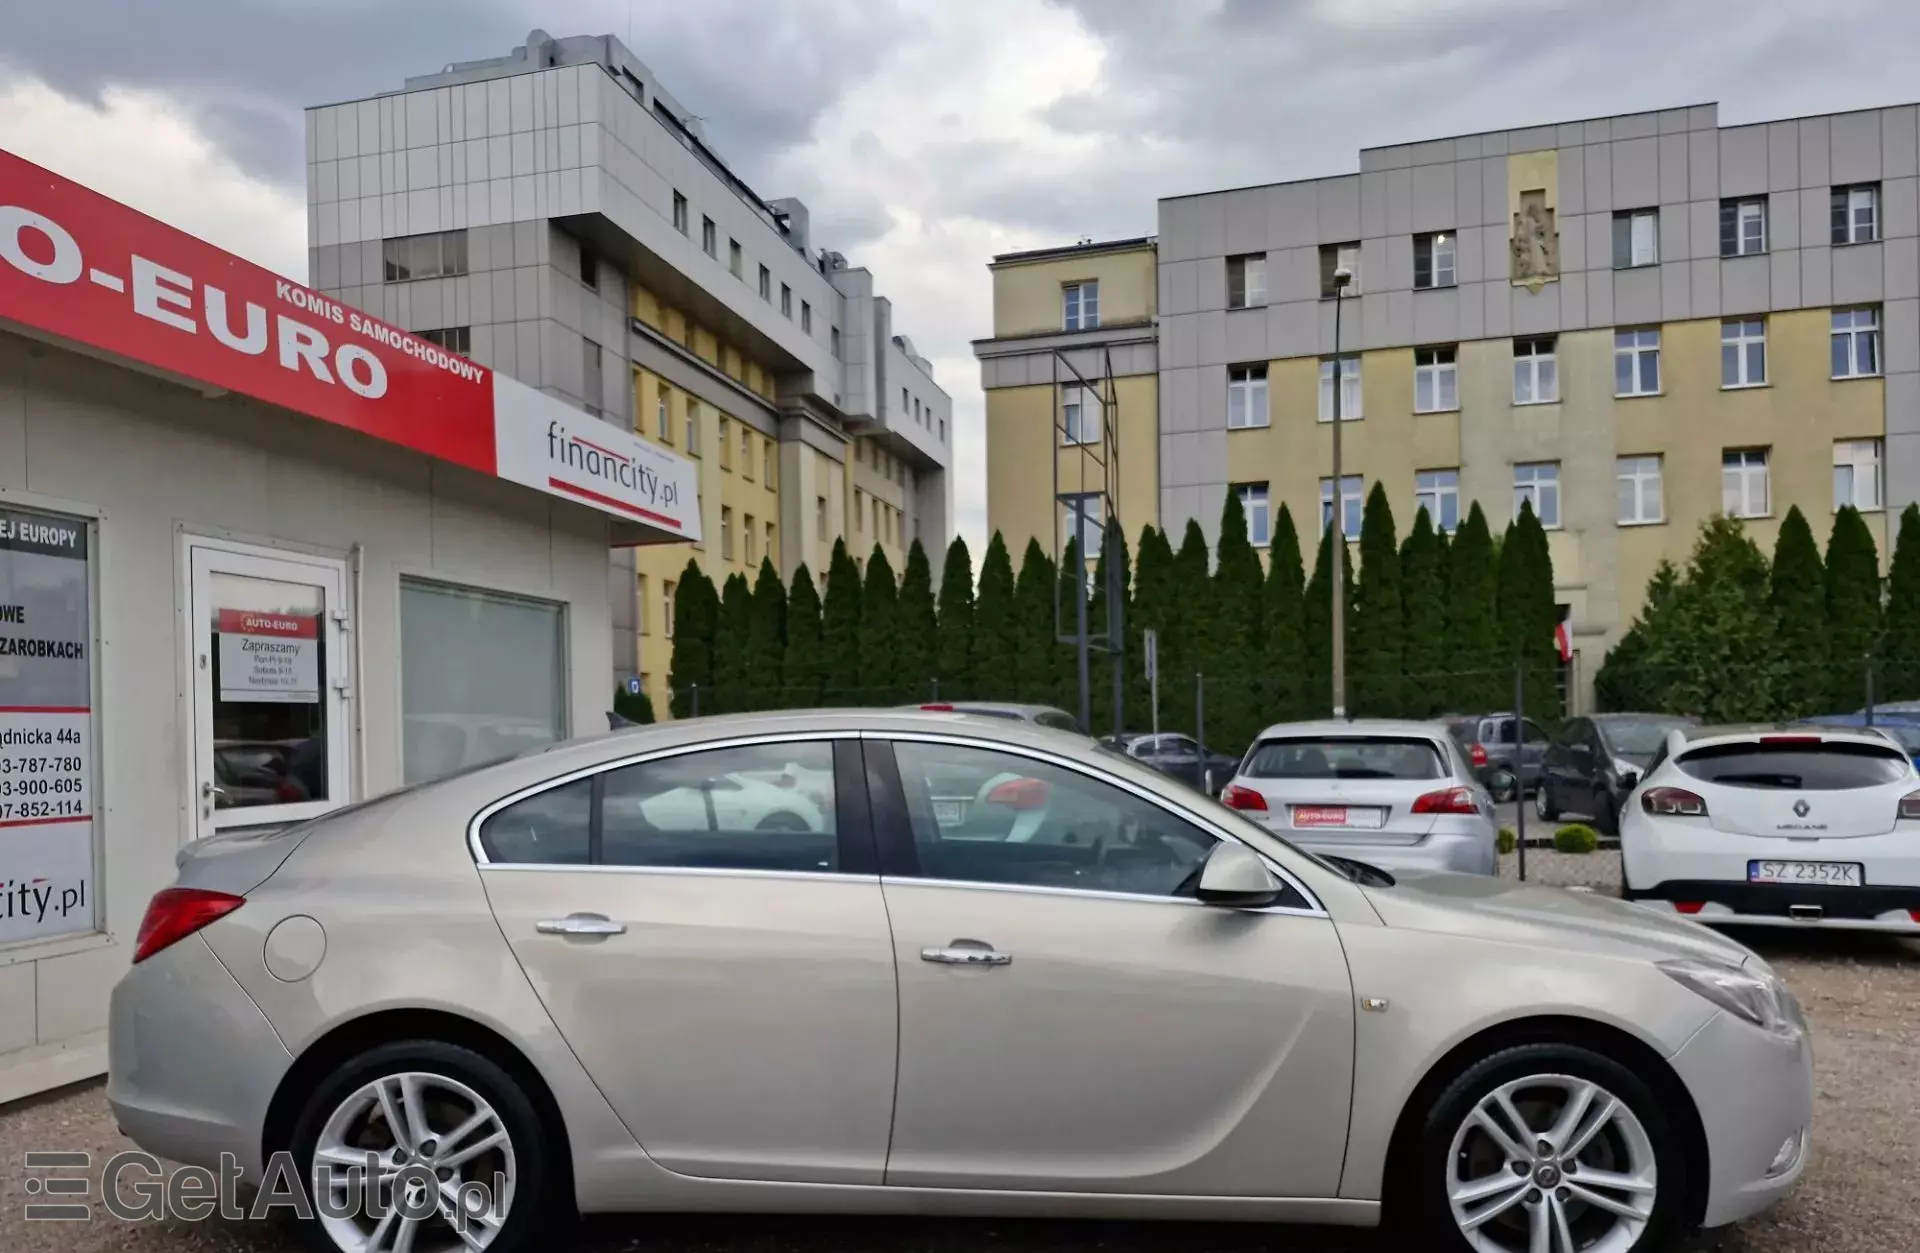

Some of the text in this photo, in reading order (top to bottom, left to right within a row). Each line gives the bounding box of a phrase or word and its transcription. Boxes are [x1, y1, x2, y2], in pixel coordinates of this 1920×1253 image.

[276, 280, 484, 385] KOMIS SAMOCHODOWY
[547, 420, 679, 507] financity.pl
[20, 522, 77, 548] EUROPY
[0, 604, 25, 623] WE
[245, 618, 298, 631] AUTO-EURO
[0, 637, 83, 659] ZAROBKACH
[241, 638, 300, 657] Zapraszamy
[56, 728, 81, 744] 44a
[0, 757, 82, 774] 3-787-780
[0, 778, 82, 796] 3-900-605
[1763, 862, 1788, 878] SZ
[1795, 863, 1855, 881] 2352K
